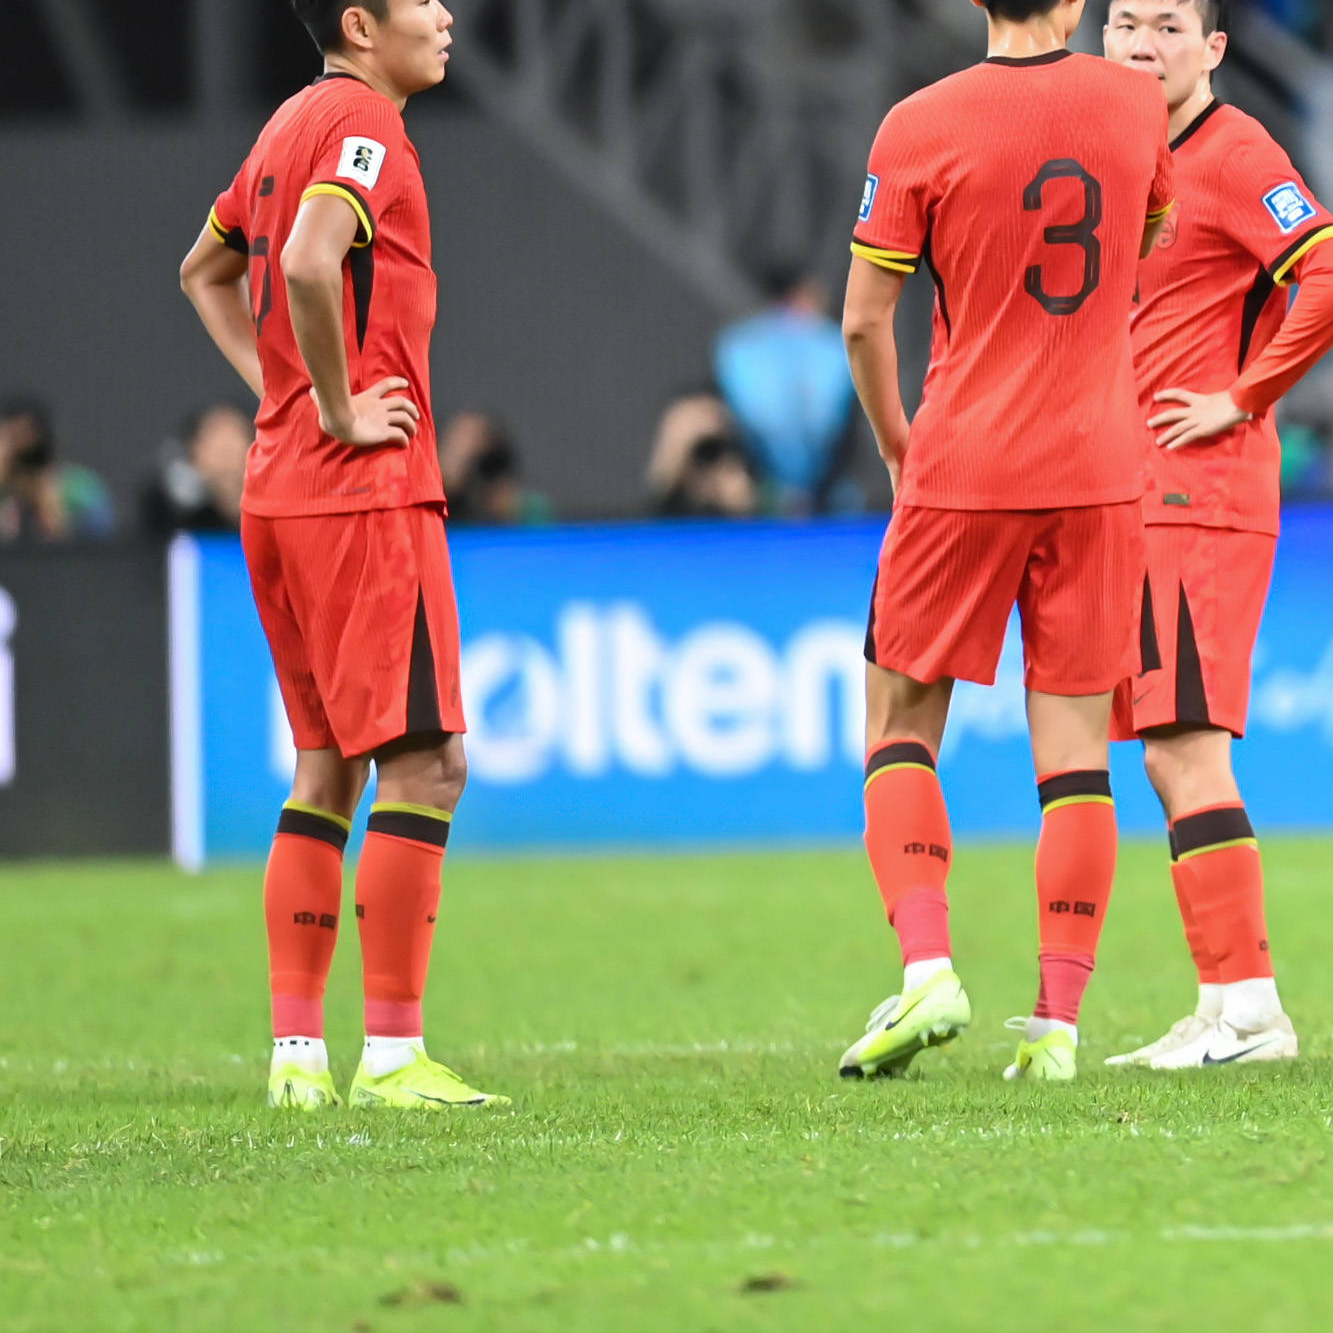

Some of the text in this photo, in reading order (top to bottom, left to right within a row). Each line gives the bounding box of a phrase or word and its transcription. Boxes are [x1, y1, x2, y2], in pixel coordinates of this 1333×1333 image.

[1023, 158, 1101, 316] 3
[268, 601, 868, 784] olten
[1049, 901, 1097, 918] 中国
